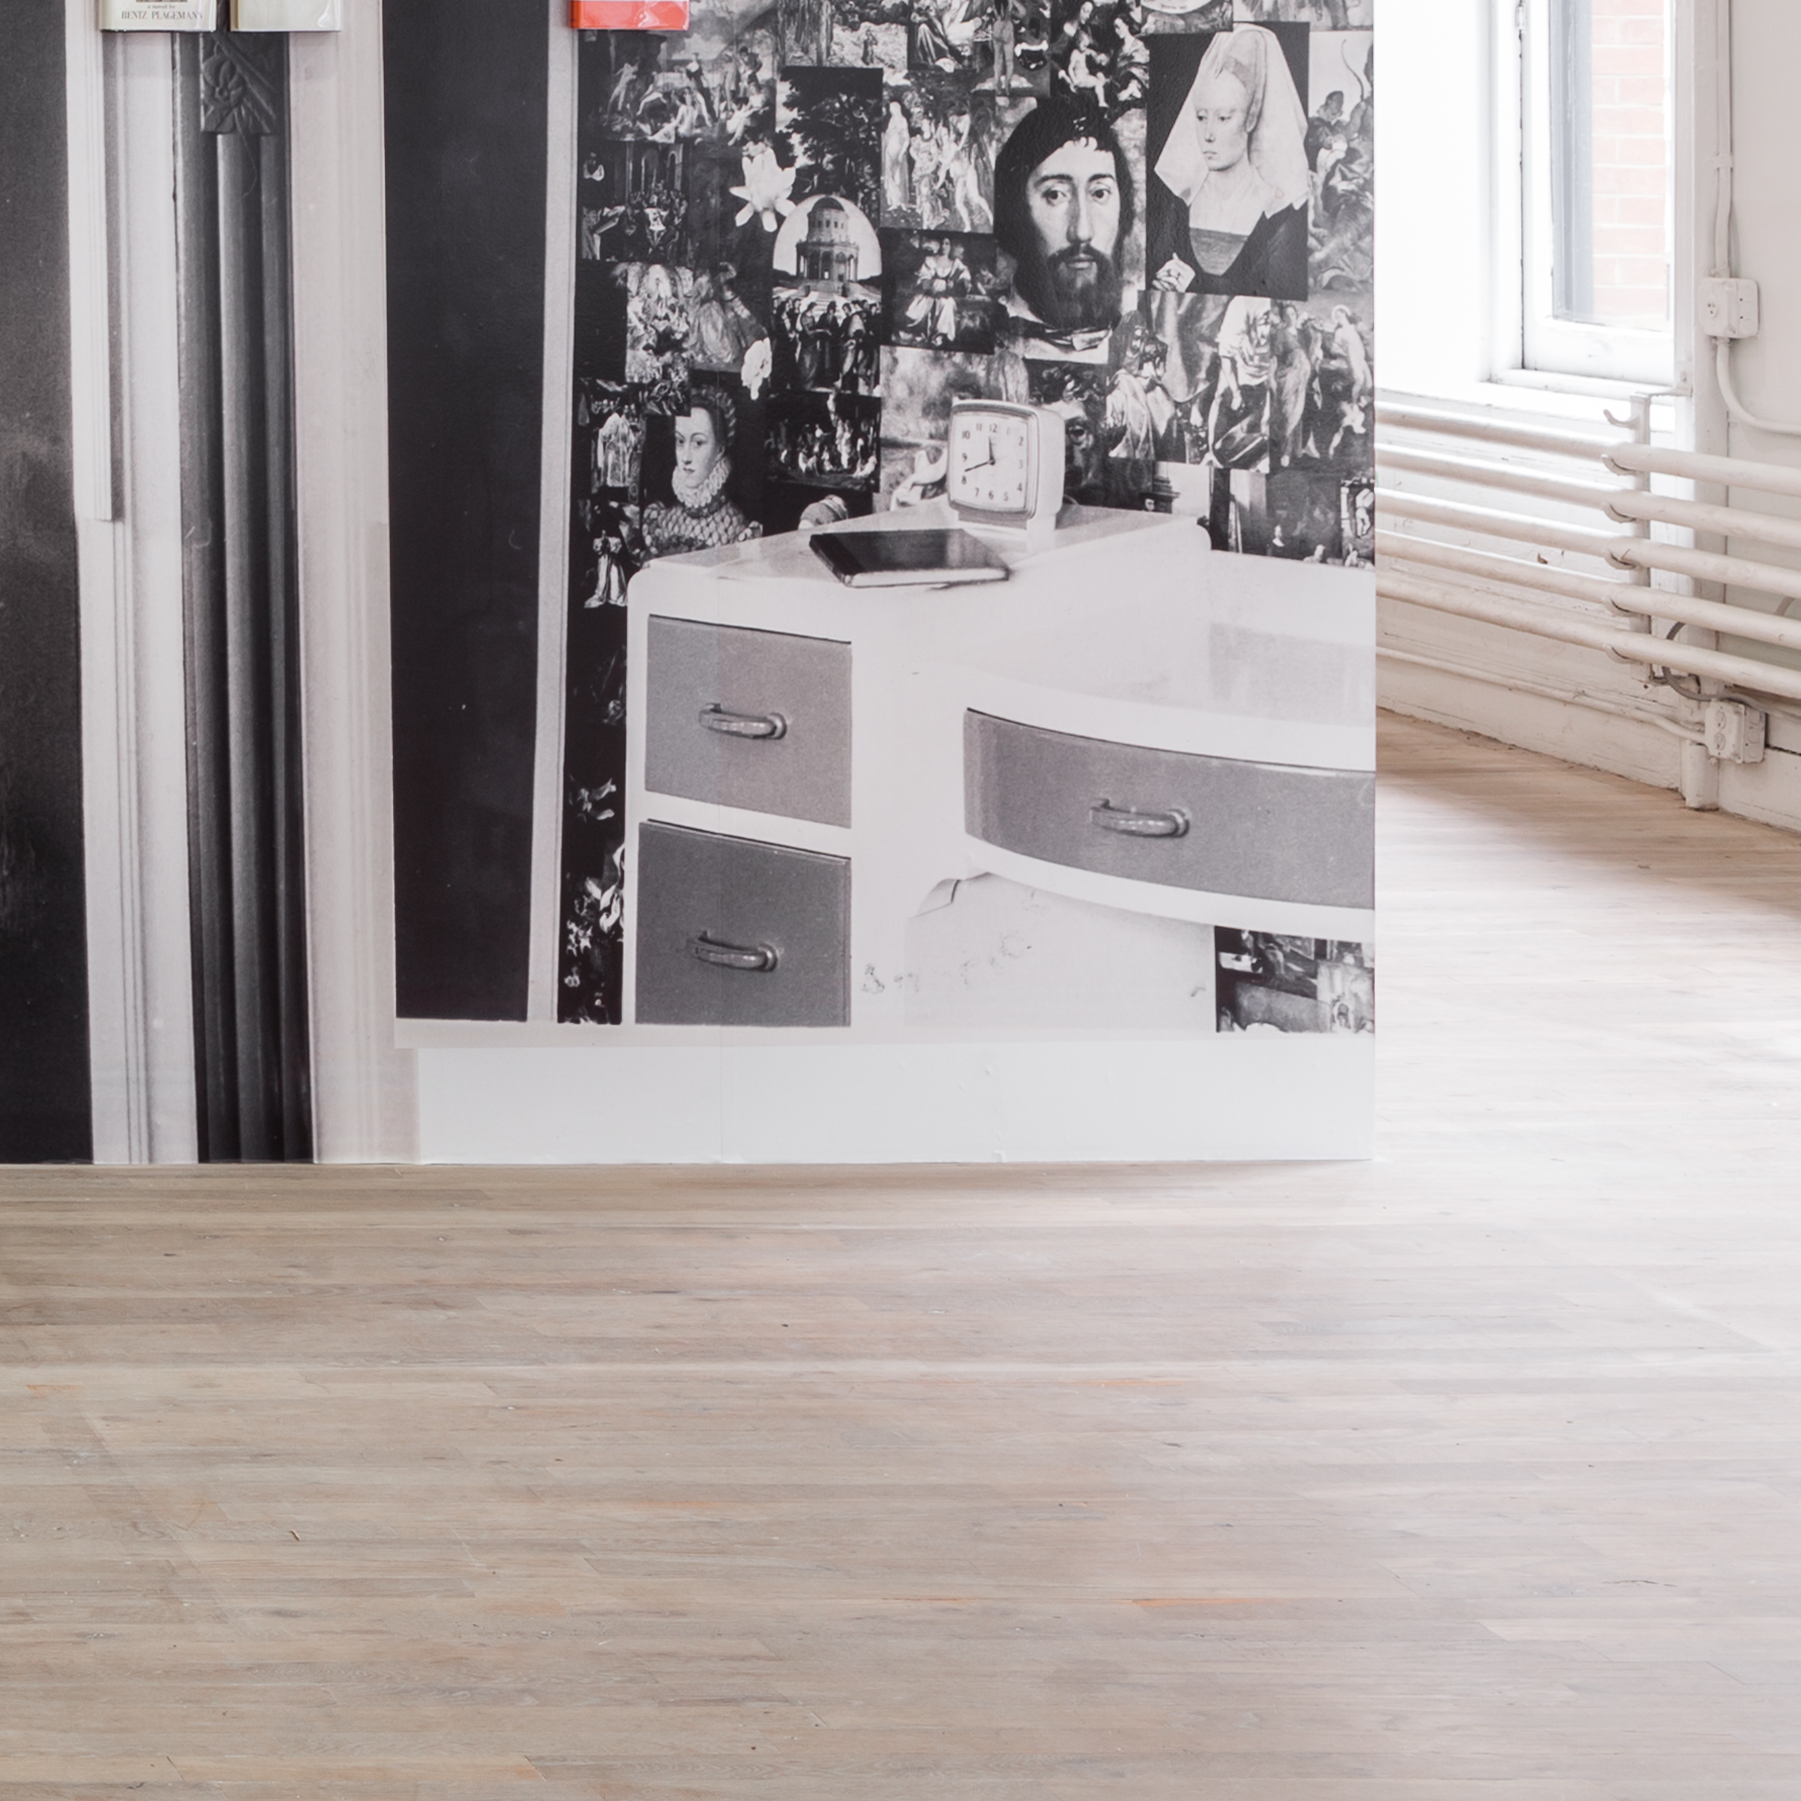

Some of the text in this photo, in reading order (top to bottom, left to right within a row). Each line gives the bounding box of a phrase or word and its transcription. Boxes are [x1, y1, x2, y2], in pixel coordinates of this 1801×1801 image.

[121, 11, 147, 19] BENTZ
[976, 423, 982, 431] 11
[989, 424, 997, 433] 12
[962, 430, 970, 439] 10
[1019, 436, 1024, 446] 2
[962, 452, 967, 462] 9
[961, 475, 967, 485] 8
[1017, 482, 1023, 492] 4
[975, 487, 980, 497] 7
[988, 490, 994, 499] 6
[1004, 492, 1008, 501] 5
